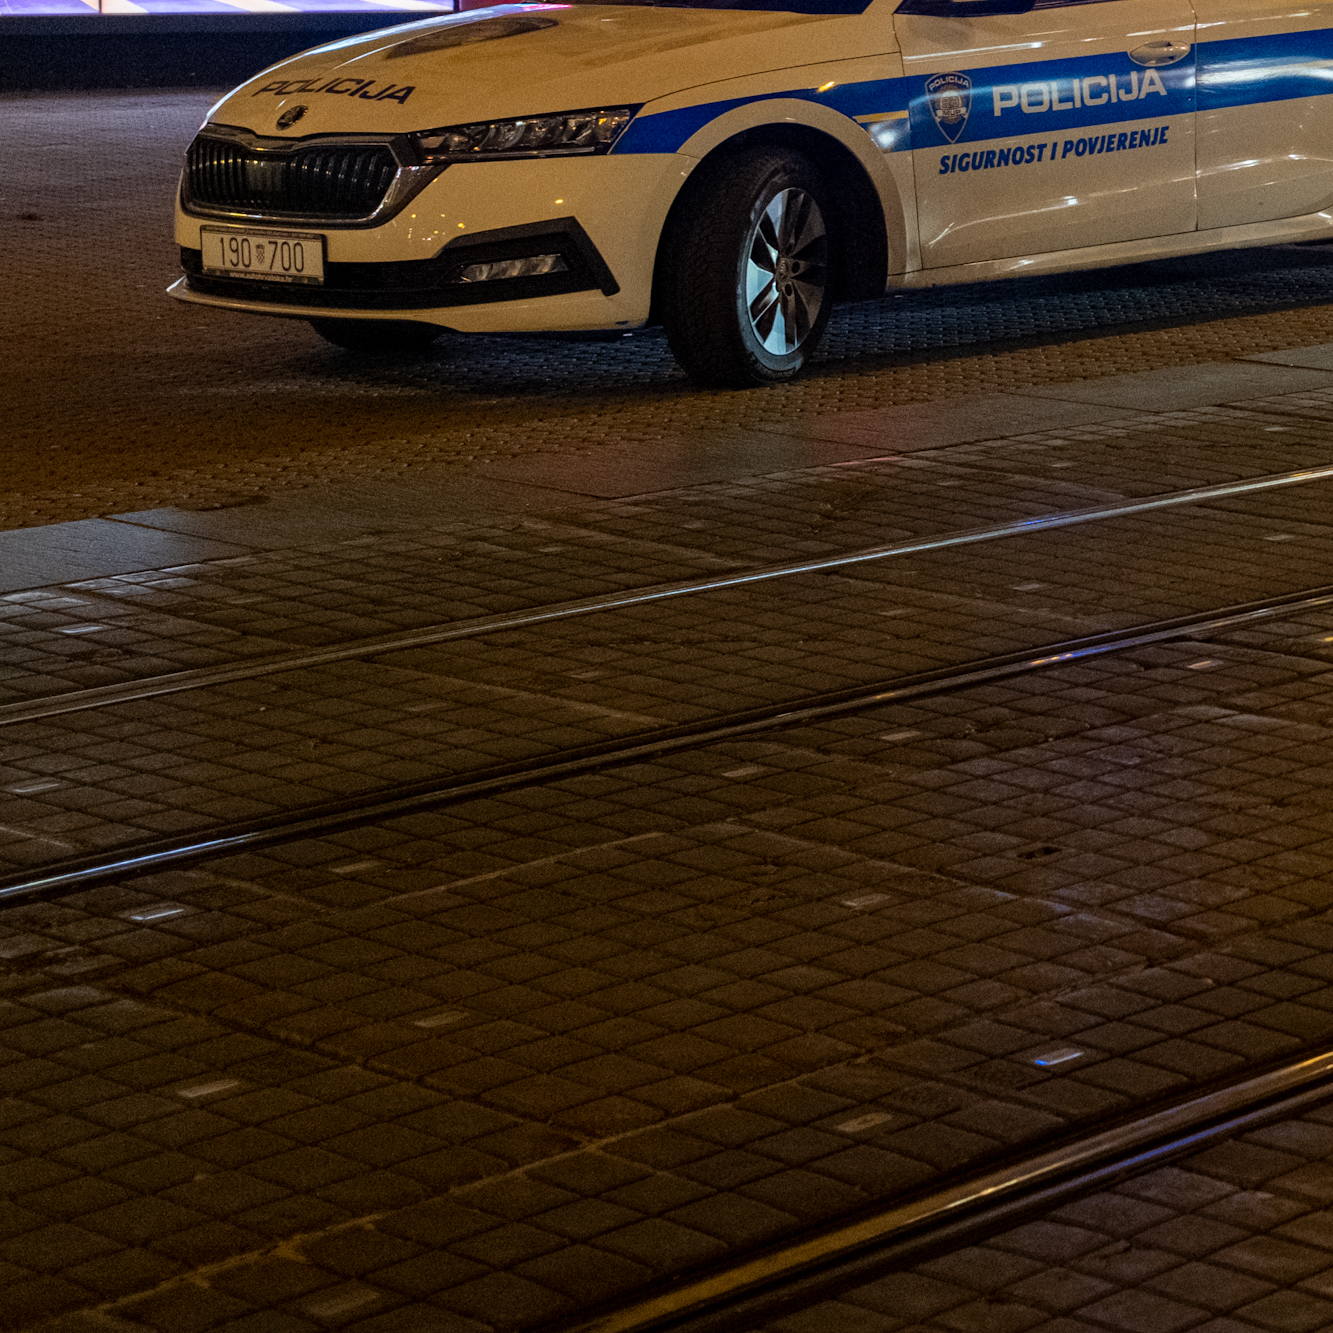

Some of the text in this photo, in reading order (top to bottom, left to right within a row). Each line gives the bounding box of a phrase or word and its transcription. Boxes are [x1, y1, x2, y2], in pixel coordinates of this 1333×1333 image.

[251, 77, 416, 105] POLICIJA
[929, 75, 970, 92] POLICIJA
[992, 68, 1168, 117] POLICIJA
[942, 108, 961, 117] MUP
[939, 126, 1170, 175] SIGURNOST I POVJERENJE
[220, 237, 305, 273] 190 700
